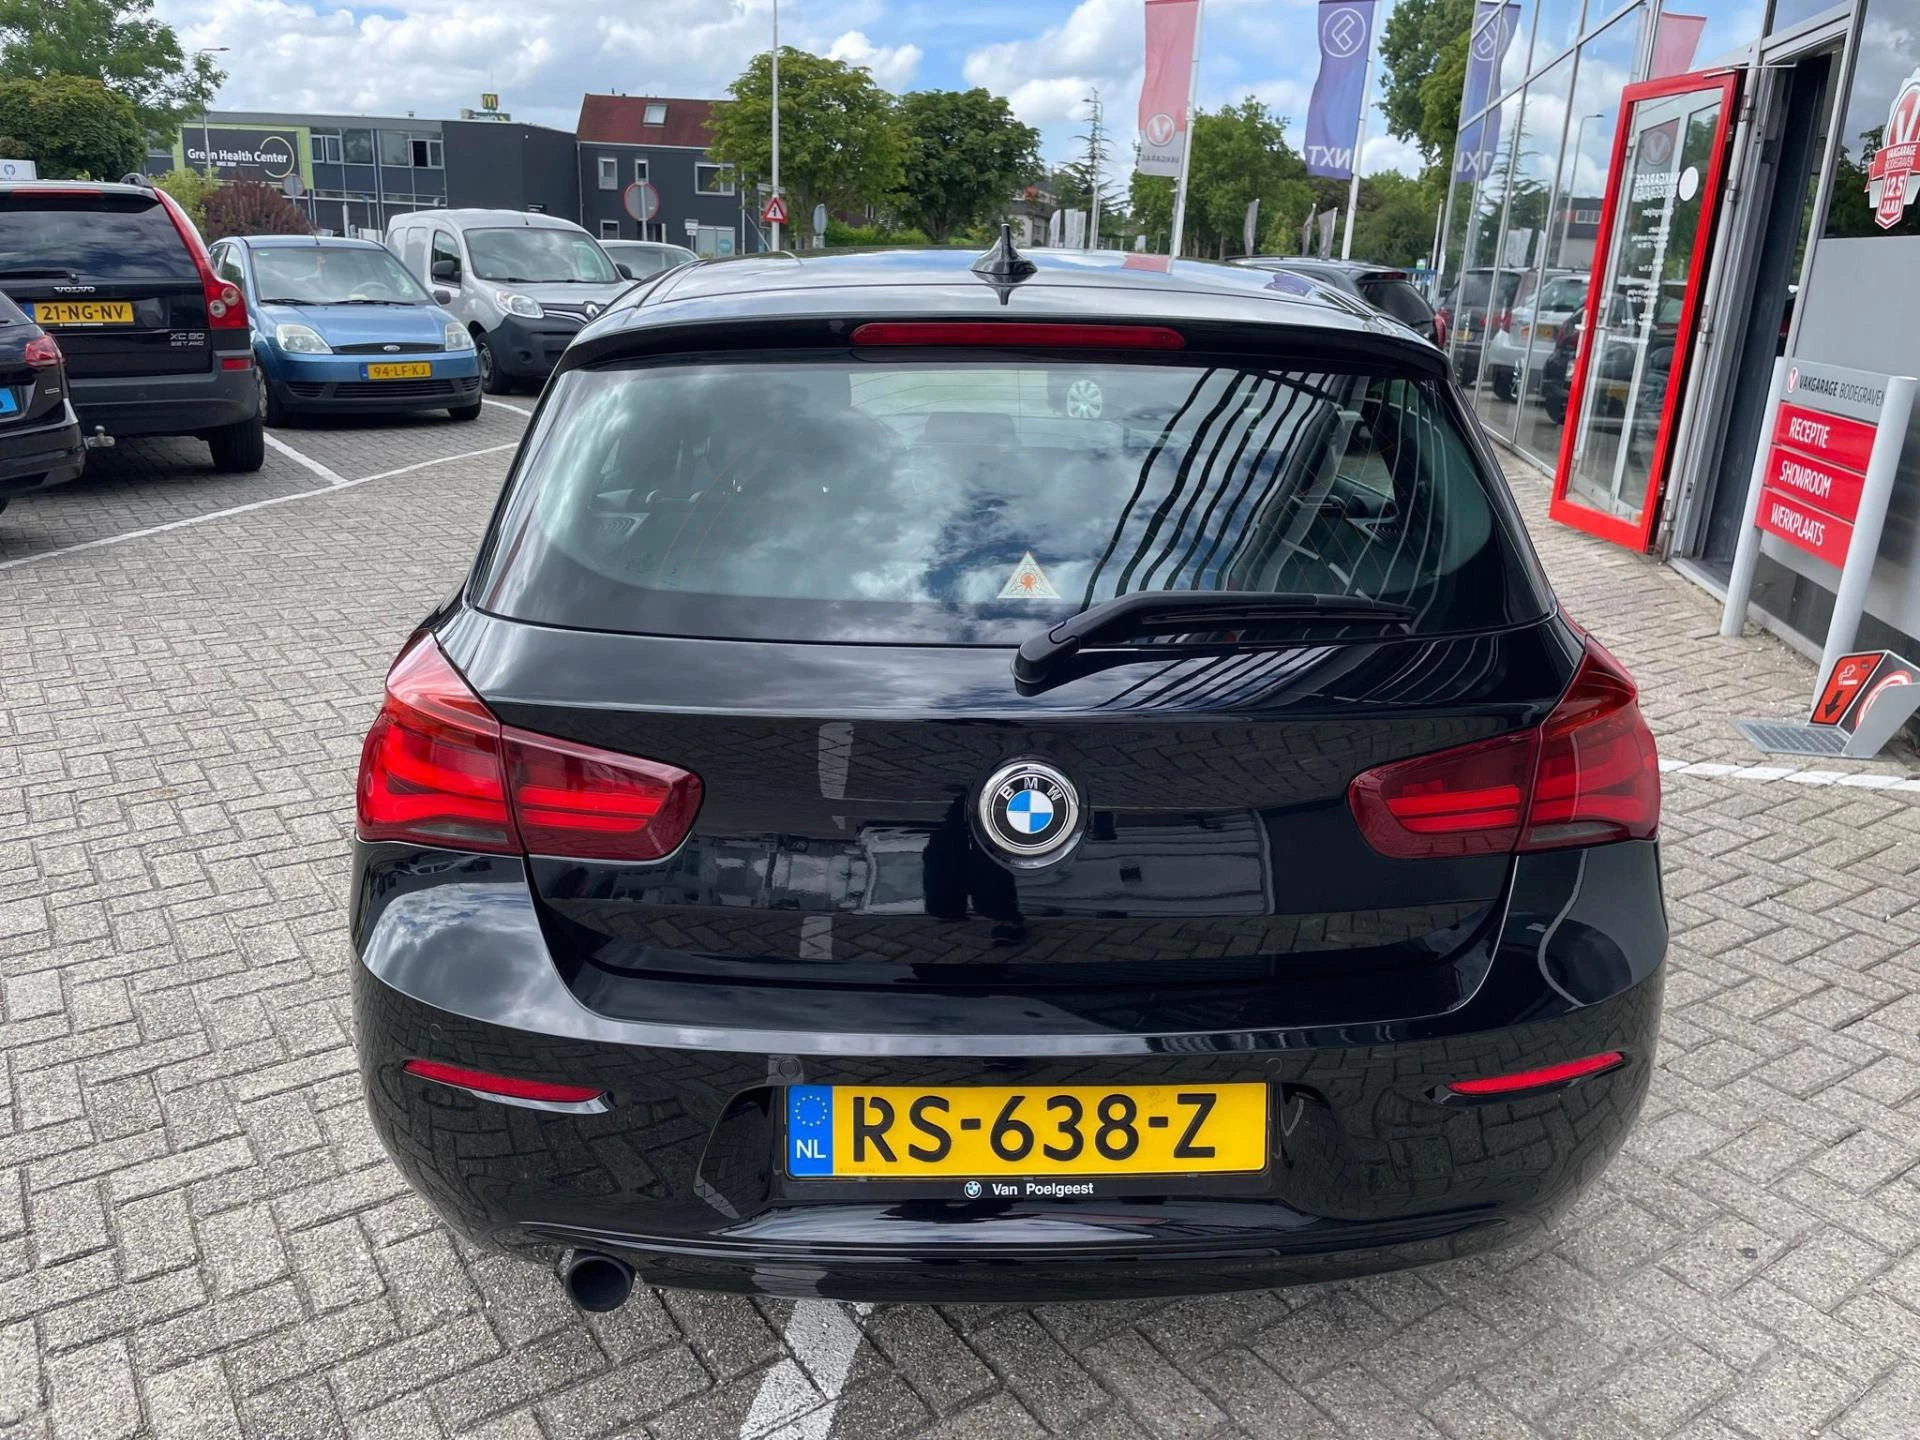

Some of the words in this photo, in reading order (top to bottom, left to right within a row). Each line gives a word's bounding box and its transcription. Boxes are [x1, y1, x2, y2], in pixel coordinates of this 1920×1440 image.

[187, 148, 218, 160] Gren
[220, 149, 252, 162] Health
[254, 151, 288, 163] Center
[1884, 176, 1905, 198] 125
[1881, 200, 1901, 214] JAAR
[42, 303, 125, 321] 21-NG-NV
[170, 332, 186, 340] XC
[374, 365, 426, 377] 94-LF-KJ
[1799, 375, 1839, 398] VAKGARAGE
[1788, 416, 1830, 449] RECEPTIE
[1779, 460, 1832, 499] SHOWROOM
[1770, 503, 1826, 546] WERKPLAATS
[1000, 777, 1063, 801] BMW
[852, 1093, 1217, 1163] RS-638-Z
[796, 1139, 827, 1159] NL
[992, 1183, 1018, 1196] Van
[1026, 1182, 1094, 1198] Poelgeest
